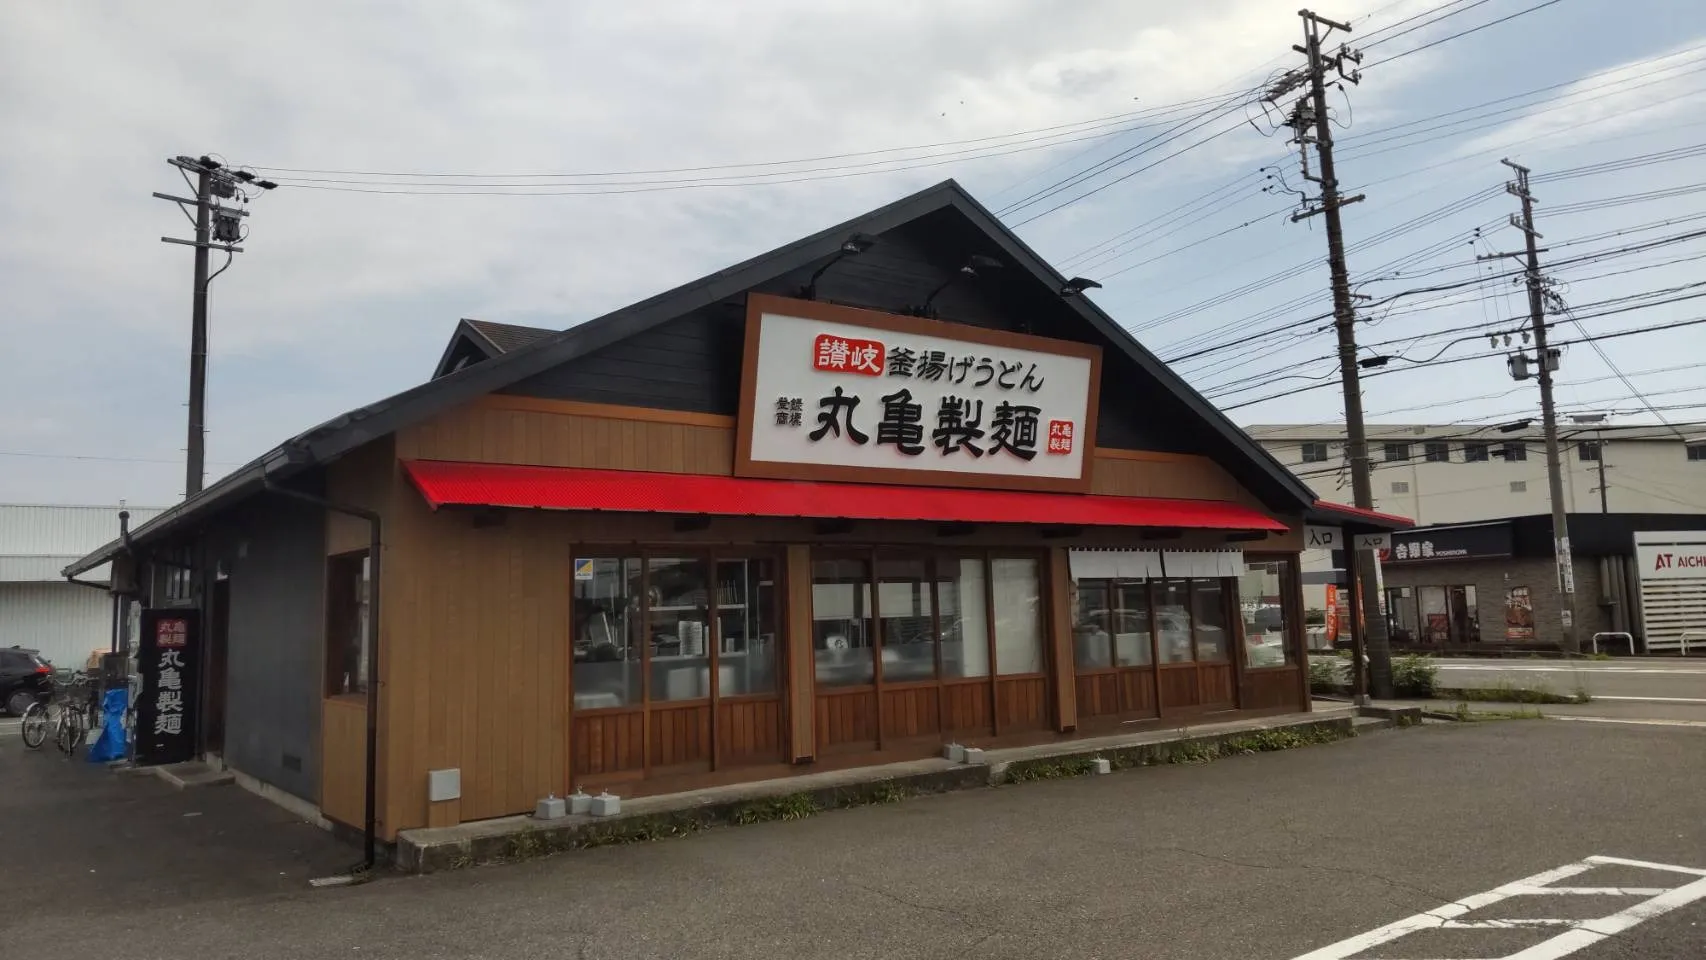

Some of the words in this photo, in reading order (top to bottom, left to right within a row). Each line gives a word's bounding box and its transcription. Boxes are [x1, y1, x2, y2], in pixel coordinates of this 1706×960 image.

[886, 347, 1044, 392] 釜揚げうどん
[809, 386, 1042, 461] 丸亀製麺
[1309, 528, 1333, 546] 入口
[1362, 536, 1383, 546] 入口
[1655, 553, 1673, 571] AT
[154, 649, 185, 735] 丸亀製麺
